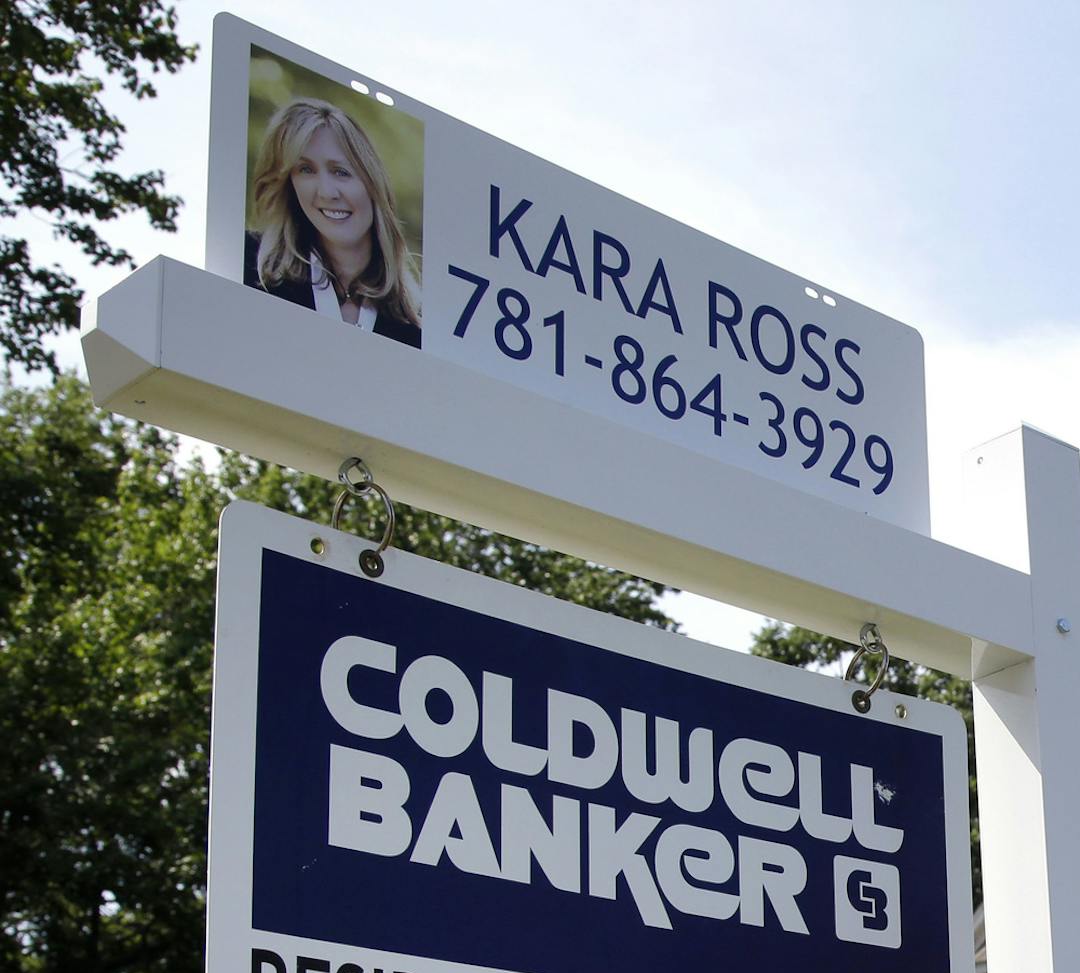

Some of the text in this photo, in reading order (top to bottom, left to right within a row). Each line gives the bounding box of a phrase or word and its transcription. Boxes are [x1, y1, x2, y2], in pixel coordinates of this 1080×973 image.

[447, 264, 894, 496] 781-864-3929
[489, 184, 865, 406] KARA ROSS
[320, 635, 904, 853] COLDWELL
[327, 743, 810, 935] BANKER
